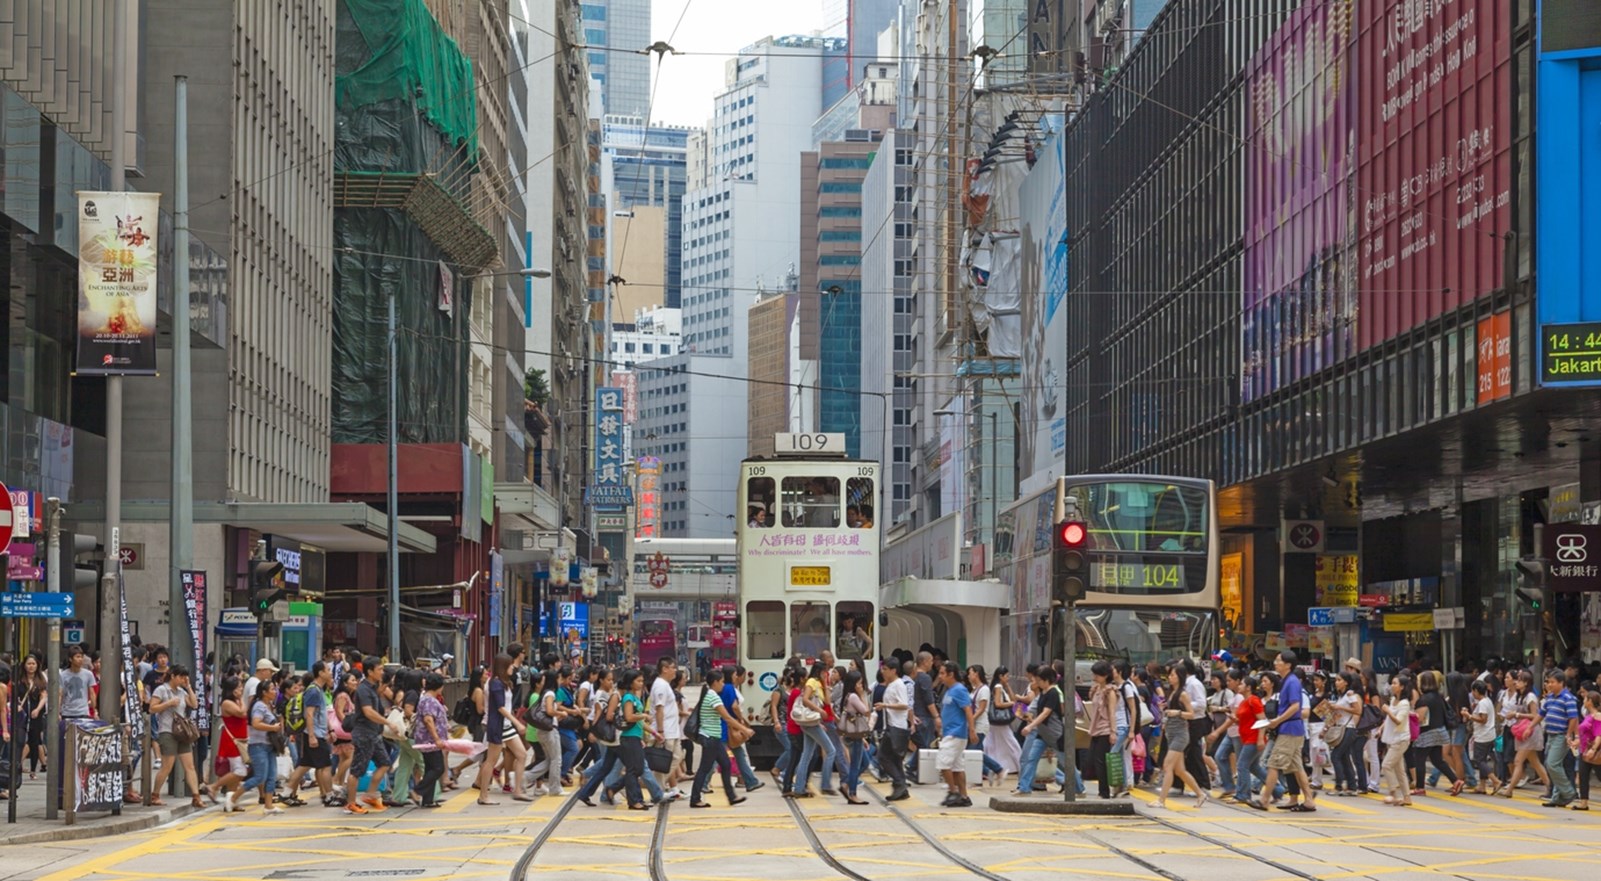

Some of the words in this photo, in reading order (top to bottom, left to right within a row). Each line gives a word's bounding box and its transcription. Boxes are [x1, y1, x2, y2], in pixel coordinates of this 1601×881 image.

[102, 267, 134, 283] 亞洲
[792, 433, 828, 450] 109
[748, 466, 766, 476] 109
[857, 467, 874, 476] 109
[1142, 564, 1179, 587] 104
[70, 632, 77, 641] C
